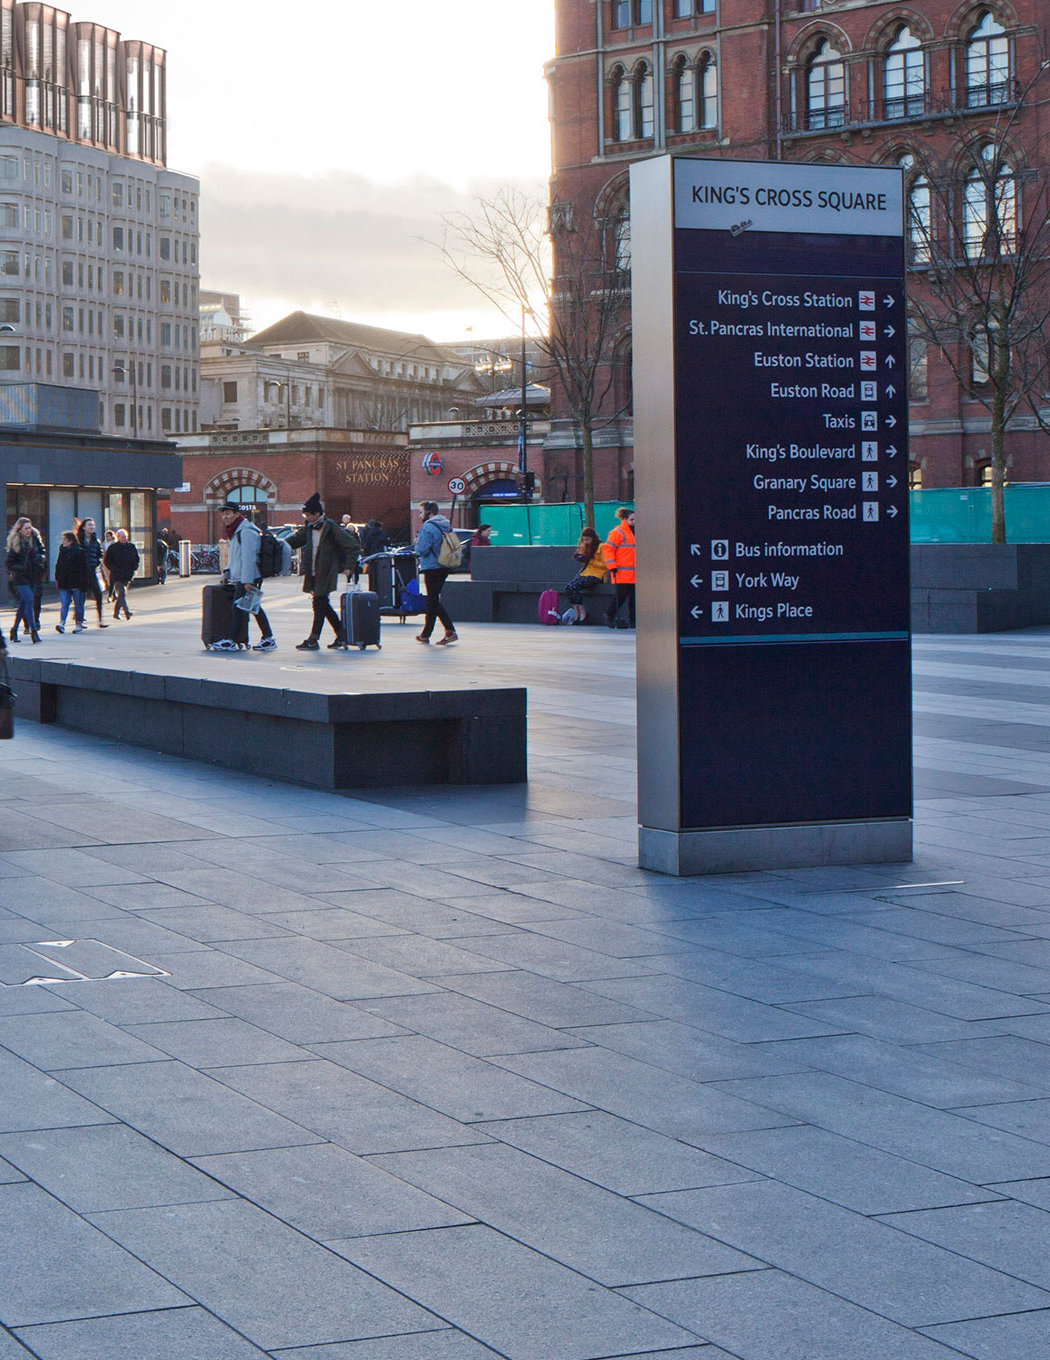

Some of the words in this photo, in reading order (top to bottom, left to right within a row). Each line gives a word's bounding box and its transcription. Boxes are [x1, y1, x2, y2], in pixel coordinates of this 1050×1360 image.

[693, 186, 750, 205] KING'S
[755, 188, 812, 207] CROSS
[818, 191, 886, 212] SQUARE
[719, 290, 758, 308] King's
[762, 291, 800, 306] Cross
[804, 292, 852, 307] Station
[690, 320, 708, 335] St.
[711, 321, 763, 336] Pancras
[768, 322, 853, 337] International
[755, 352, 801, 367] Euston
[806, 353, 853, 367] Station
[771, 383, 817, 397] Euston
[822, 384, 854, 398] Road
[823, 414, 855, 428] Taxis
[747, 444, 786, 462] King's
[790, 444, 855, 458] Boulevard
[346, 473, 389, 482] STATION
[450, 481, 464, 490] 30
[754, 475, 807, 492] Granary
[811, 475, 856, 492] Square
[769, 506, 819, 519] Pancras
[824, 505, 856, 519] Road
[736, 543, 760, 556] Bus
[765, 541, 843, 556] information
[736, 573, 767, 587] York
[771, 573, 799, 590] Way
[736, 604, 773, 621] Kings
[778, 603, 812, 617] Place
